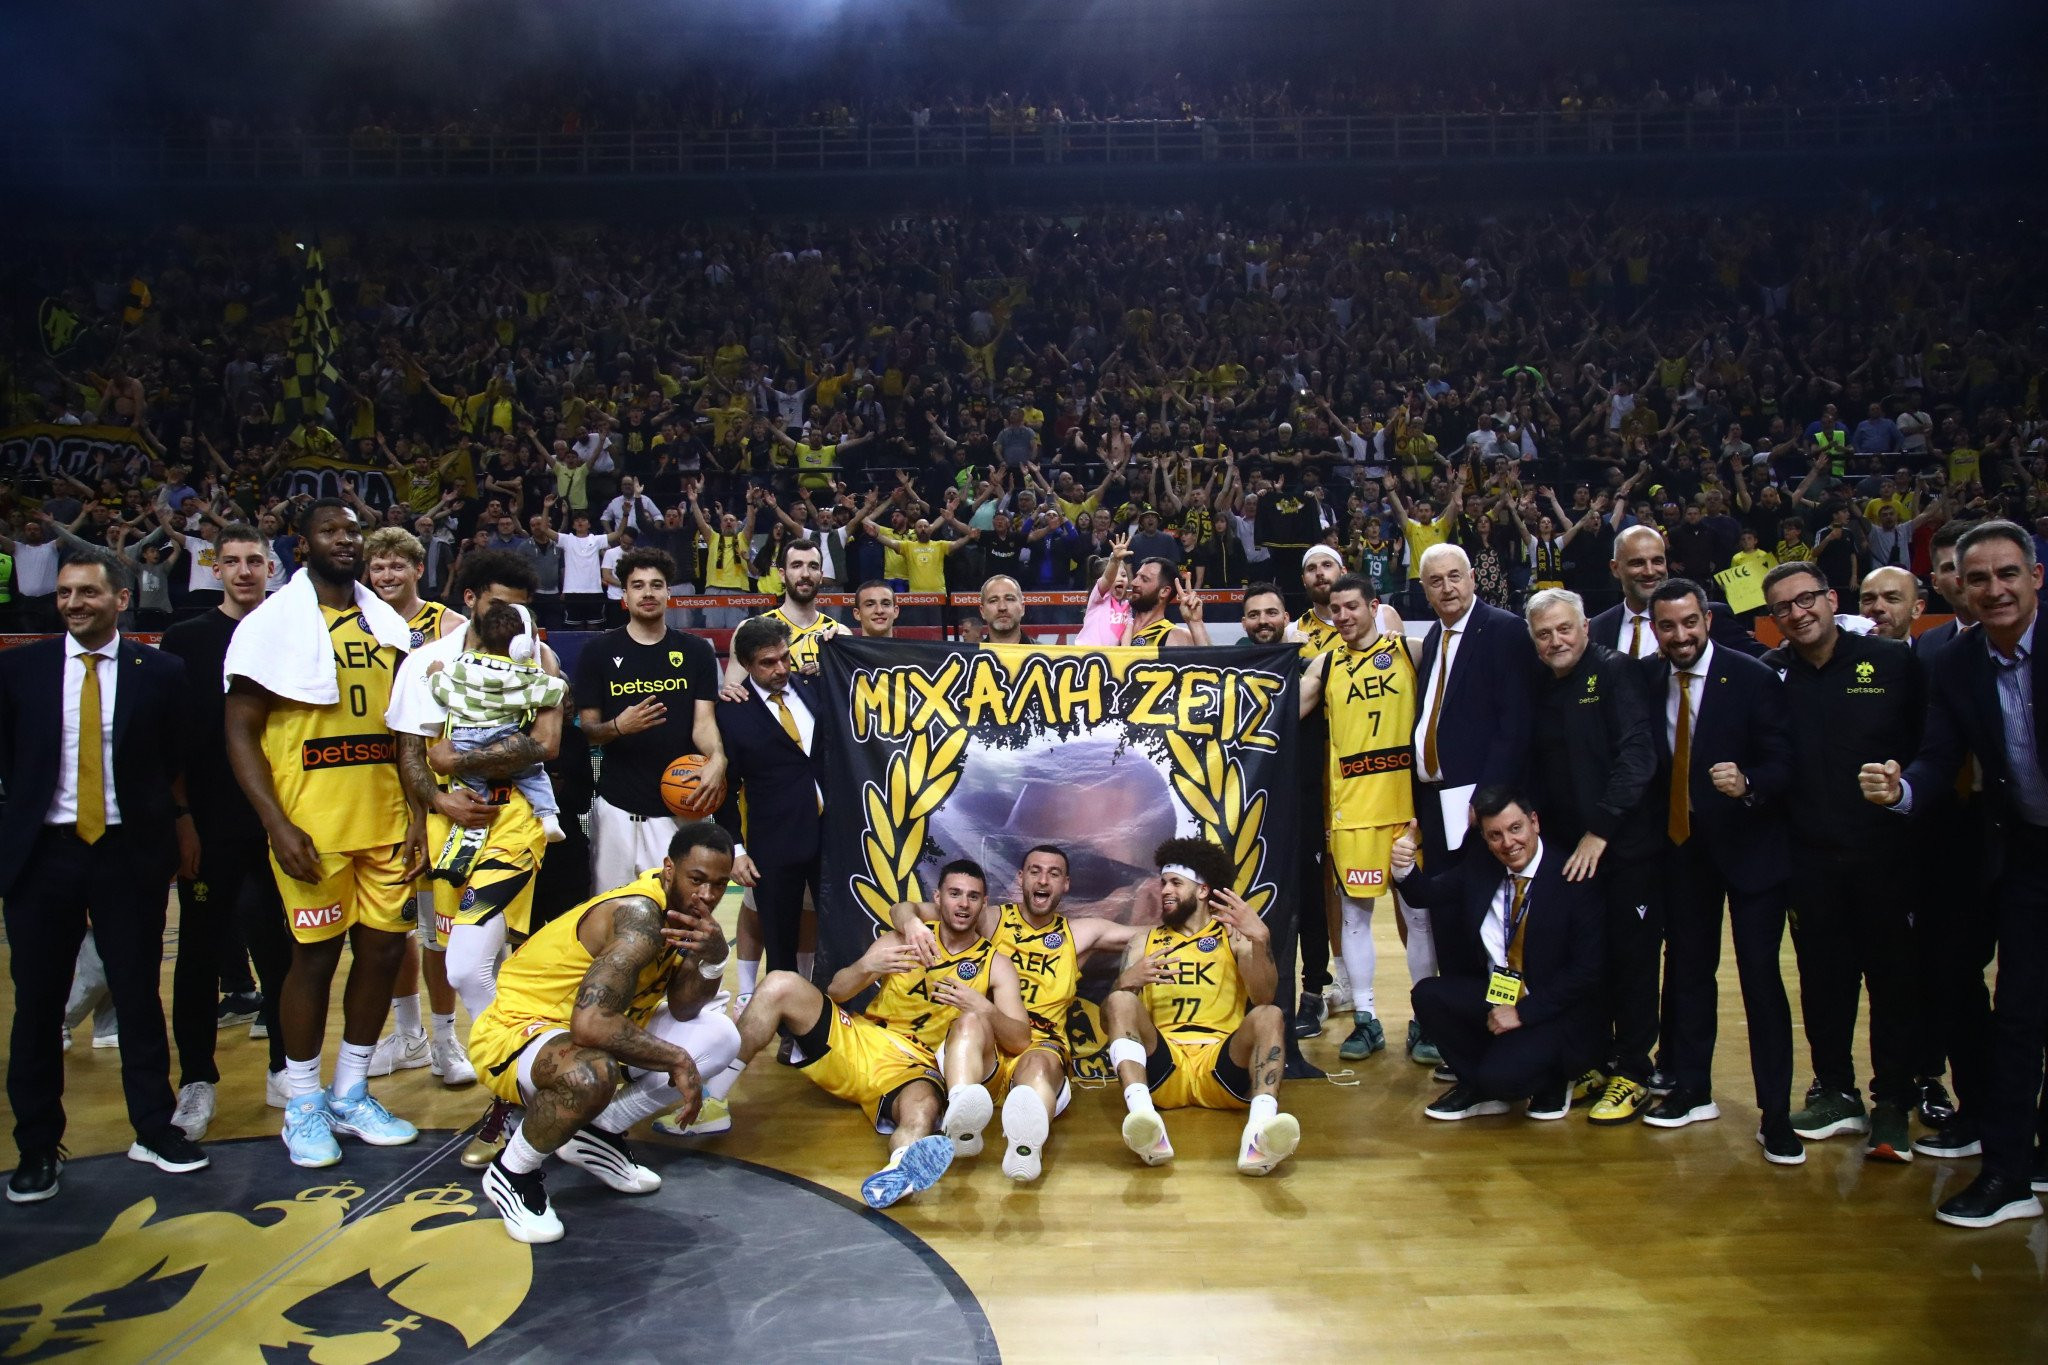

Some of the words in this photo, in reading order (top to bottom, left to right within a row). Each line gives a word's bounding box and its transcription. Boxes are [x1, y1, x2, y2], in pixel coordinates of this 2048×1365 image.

[1370, 561, 1382, 576] 19
[954, 595, 981, 604] betss
[1022, 595, 1051, 603] tsson
[1062, 594, 1089, 603] bets
[610, 677, 688, 697] betsson
[1346, 672, 1399, 704] AEK
[350, 684, 367, 717] 0
[853, 656, 1105, 739] ΜΙΧΑΛΗ
[1125, 667, 1283, 748] ΖΕΙΣ
[1368, 711, 1381, 737] 7
[1339, 751, 1413, 777] betsso
[1347, 870, 1382, 885] AVIS
[295, 904, 342, 927] AVIS
[1011, 950, 1061, 978] AEK
[1171, 997, 1202, 1024] 77
